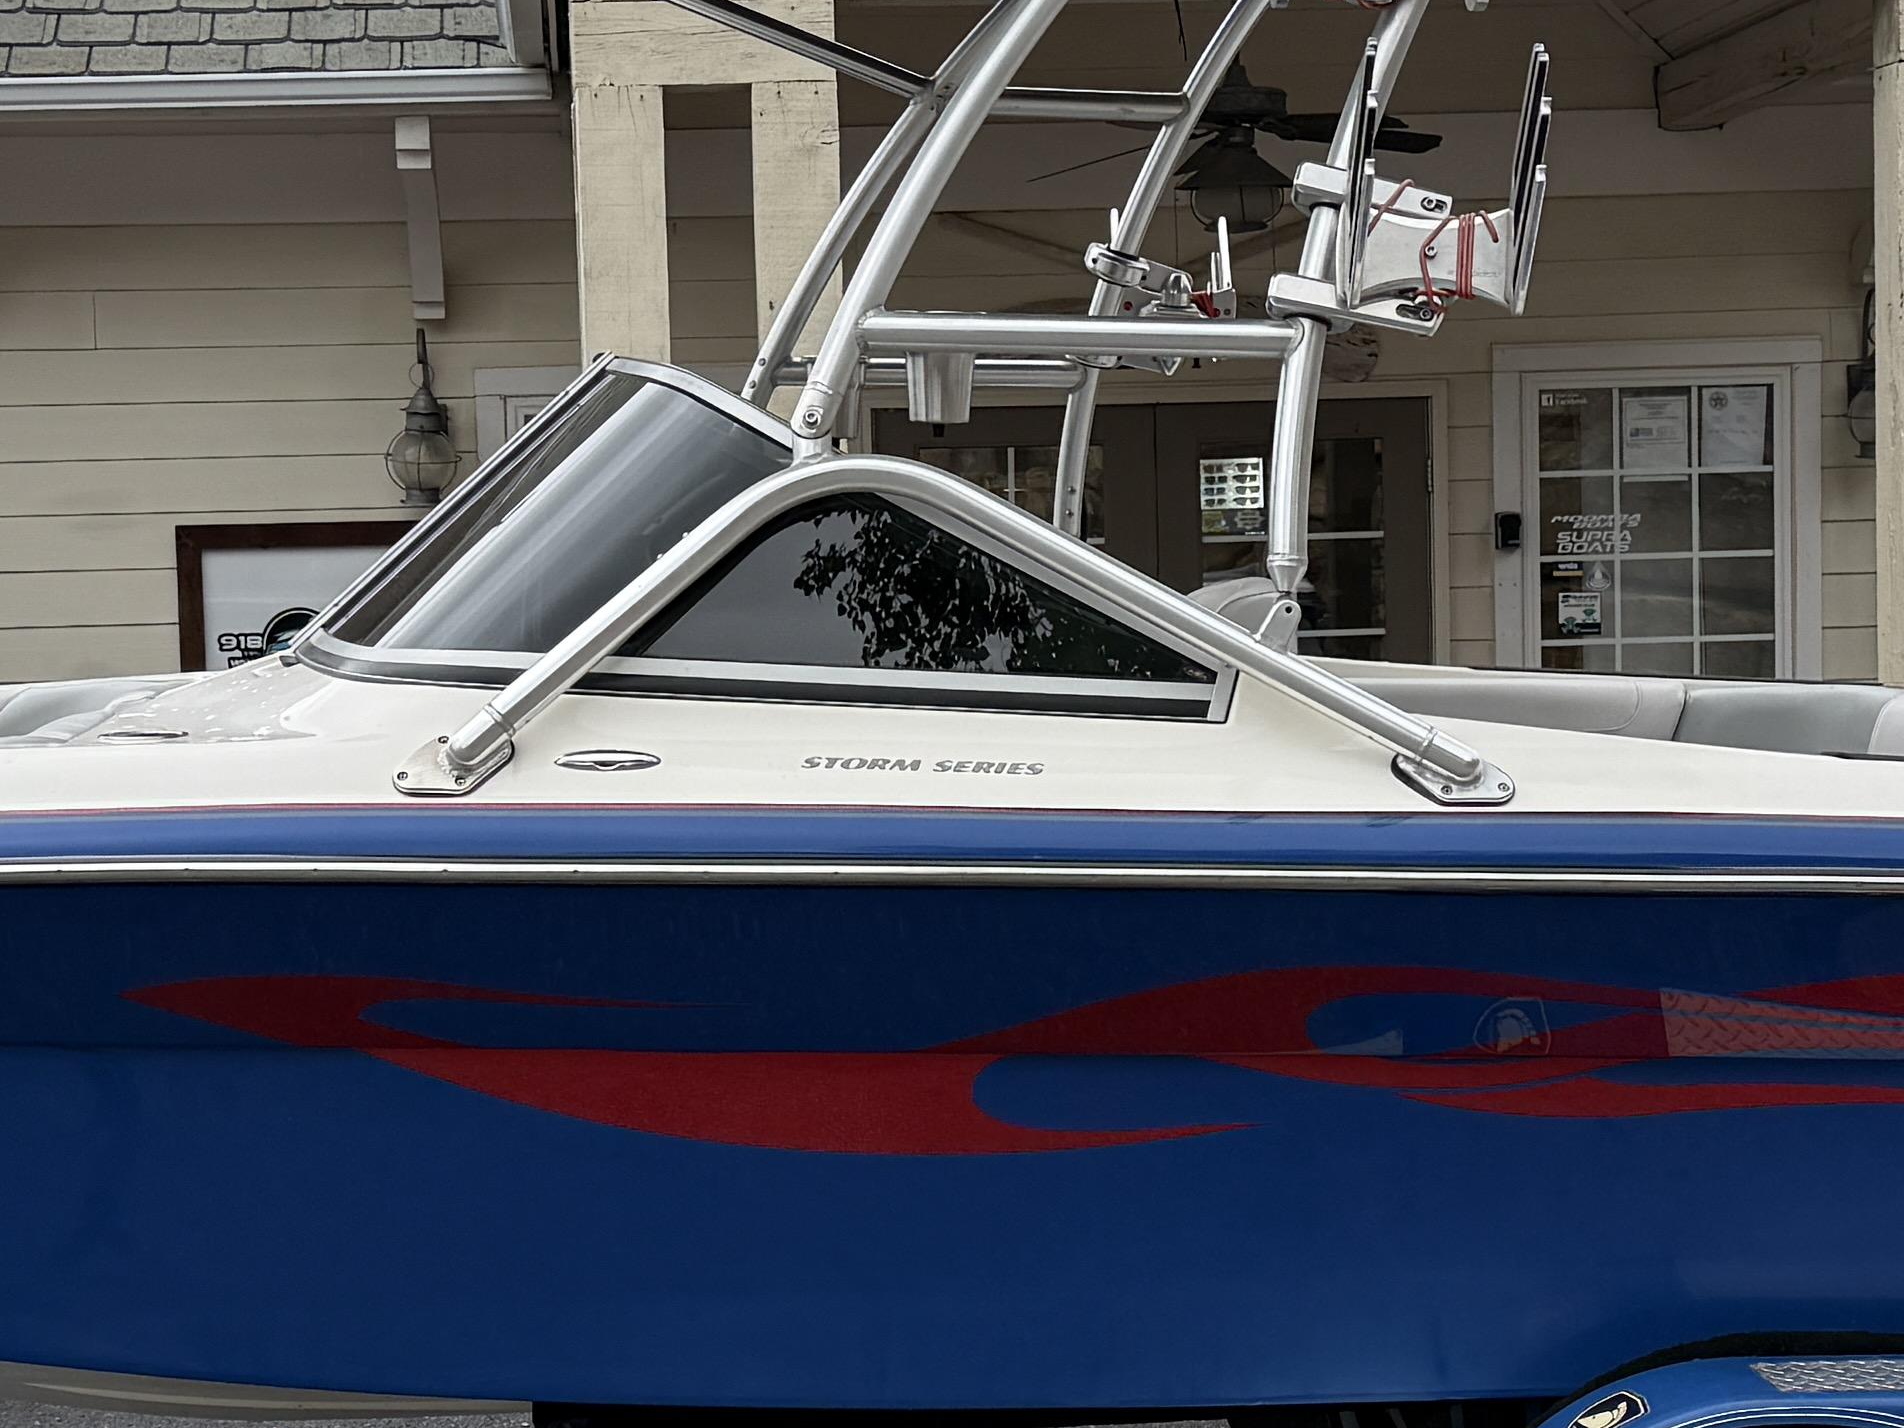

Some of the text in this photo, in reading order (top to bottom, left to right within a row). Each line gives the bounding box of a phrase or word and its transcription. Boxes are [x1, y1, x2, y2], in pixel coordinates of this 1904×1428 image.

[1556, 530, 1632, 544] SUPRA
[1557, 541, 1630, 554] BOATS
[218, 633, 264, 652] 918
[801, 756, 1045, 776] STORM SERIES
